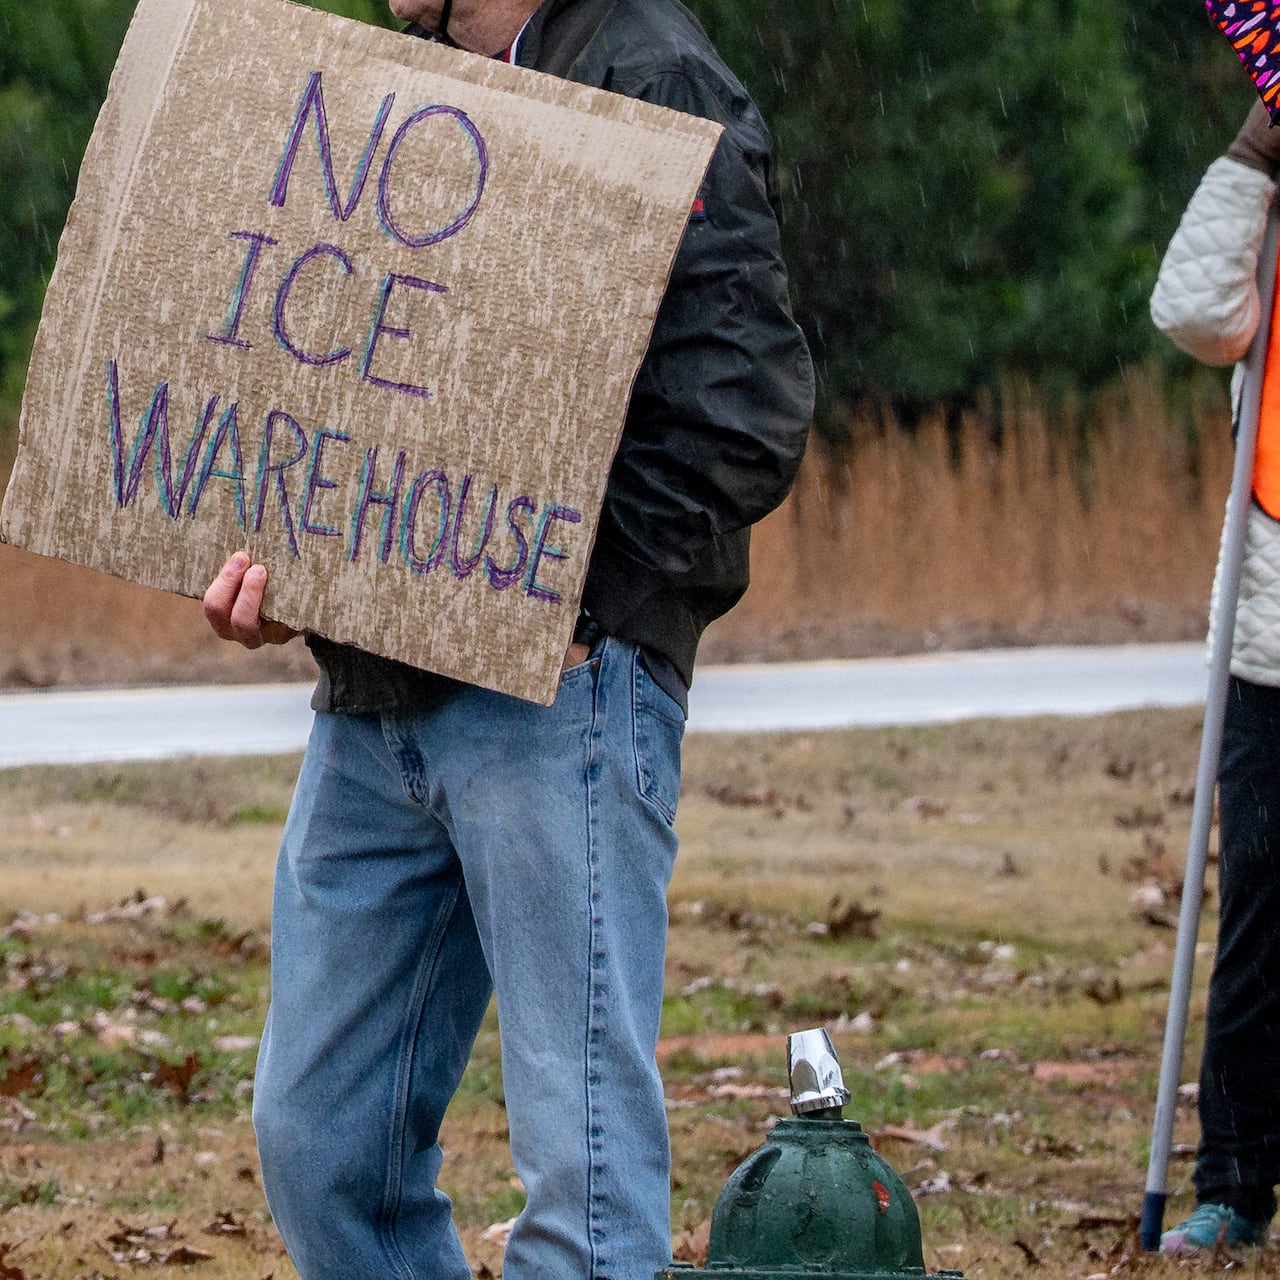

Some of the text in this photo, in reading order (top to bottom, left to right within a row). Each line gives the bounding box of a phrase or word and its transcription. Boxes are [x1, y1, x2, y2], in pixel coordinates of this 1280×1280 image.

[269, 70, 489, 249] NO
[206, 231, 448, 398] ICE
[109, 360, 581, 603] WAREHOUSE
